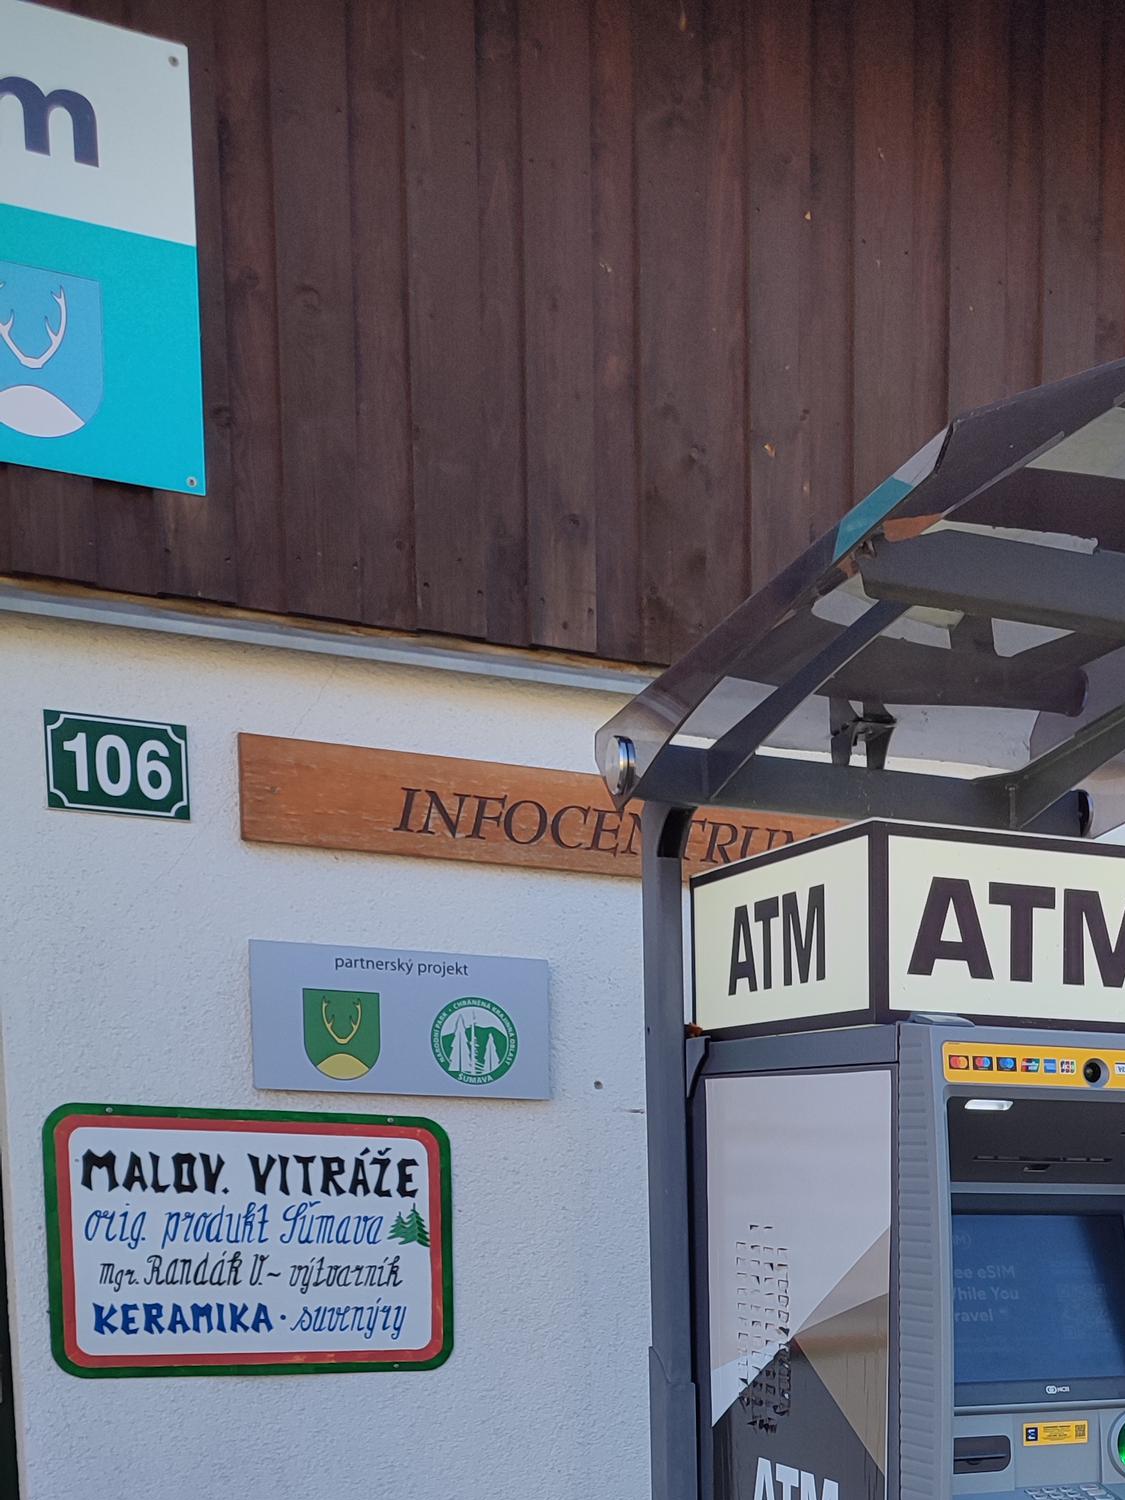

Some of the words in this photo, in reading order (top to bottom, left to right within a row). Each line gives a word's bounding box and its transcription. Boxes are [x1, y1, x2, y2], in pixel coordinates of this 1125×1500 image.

[63, 732, 172, 800] 106
[728, 883, 826, 996] ATM
[334, 957, 414, 975] partnerský
[417, 961, 469, 978] projekt
[80, 1148, 230, 1196] MALOV.
[247, 1146, 419, 1198] VITRÁŽE
[84, 1203, 146, 1250] orig.
[162, 1202, 269, 1250] produkt
[143, 1250, 243, 1286] Randák
[289, 1255, 403, 1294] výtvarník
[991, 1287, 1019, 1300] You
[93, 1302, 274, 1336] KERAMIKA
[290, 1297, 407, 1340] suvenýry
